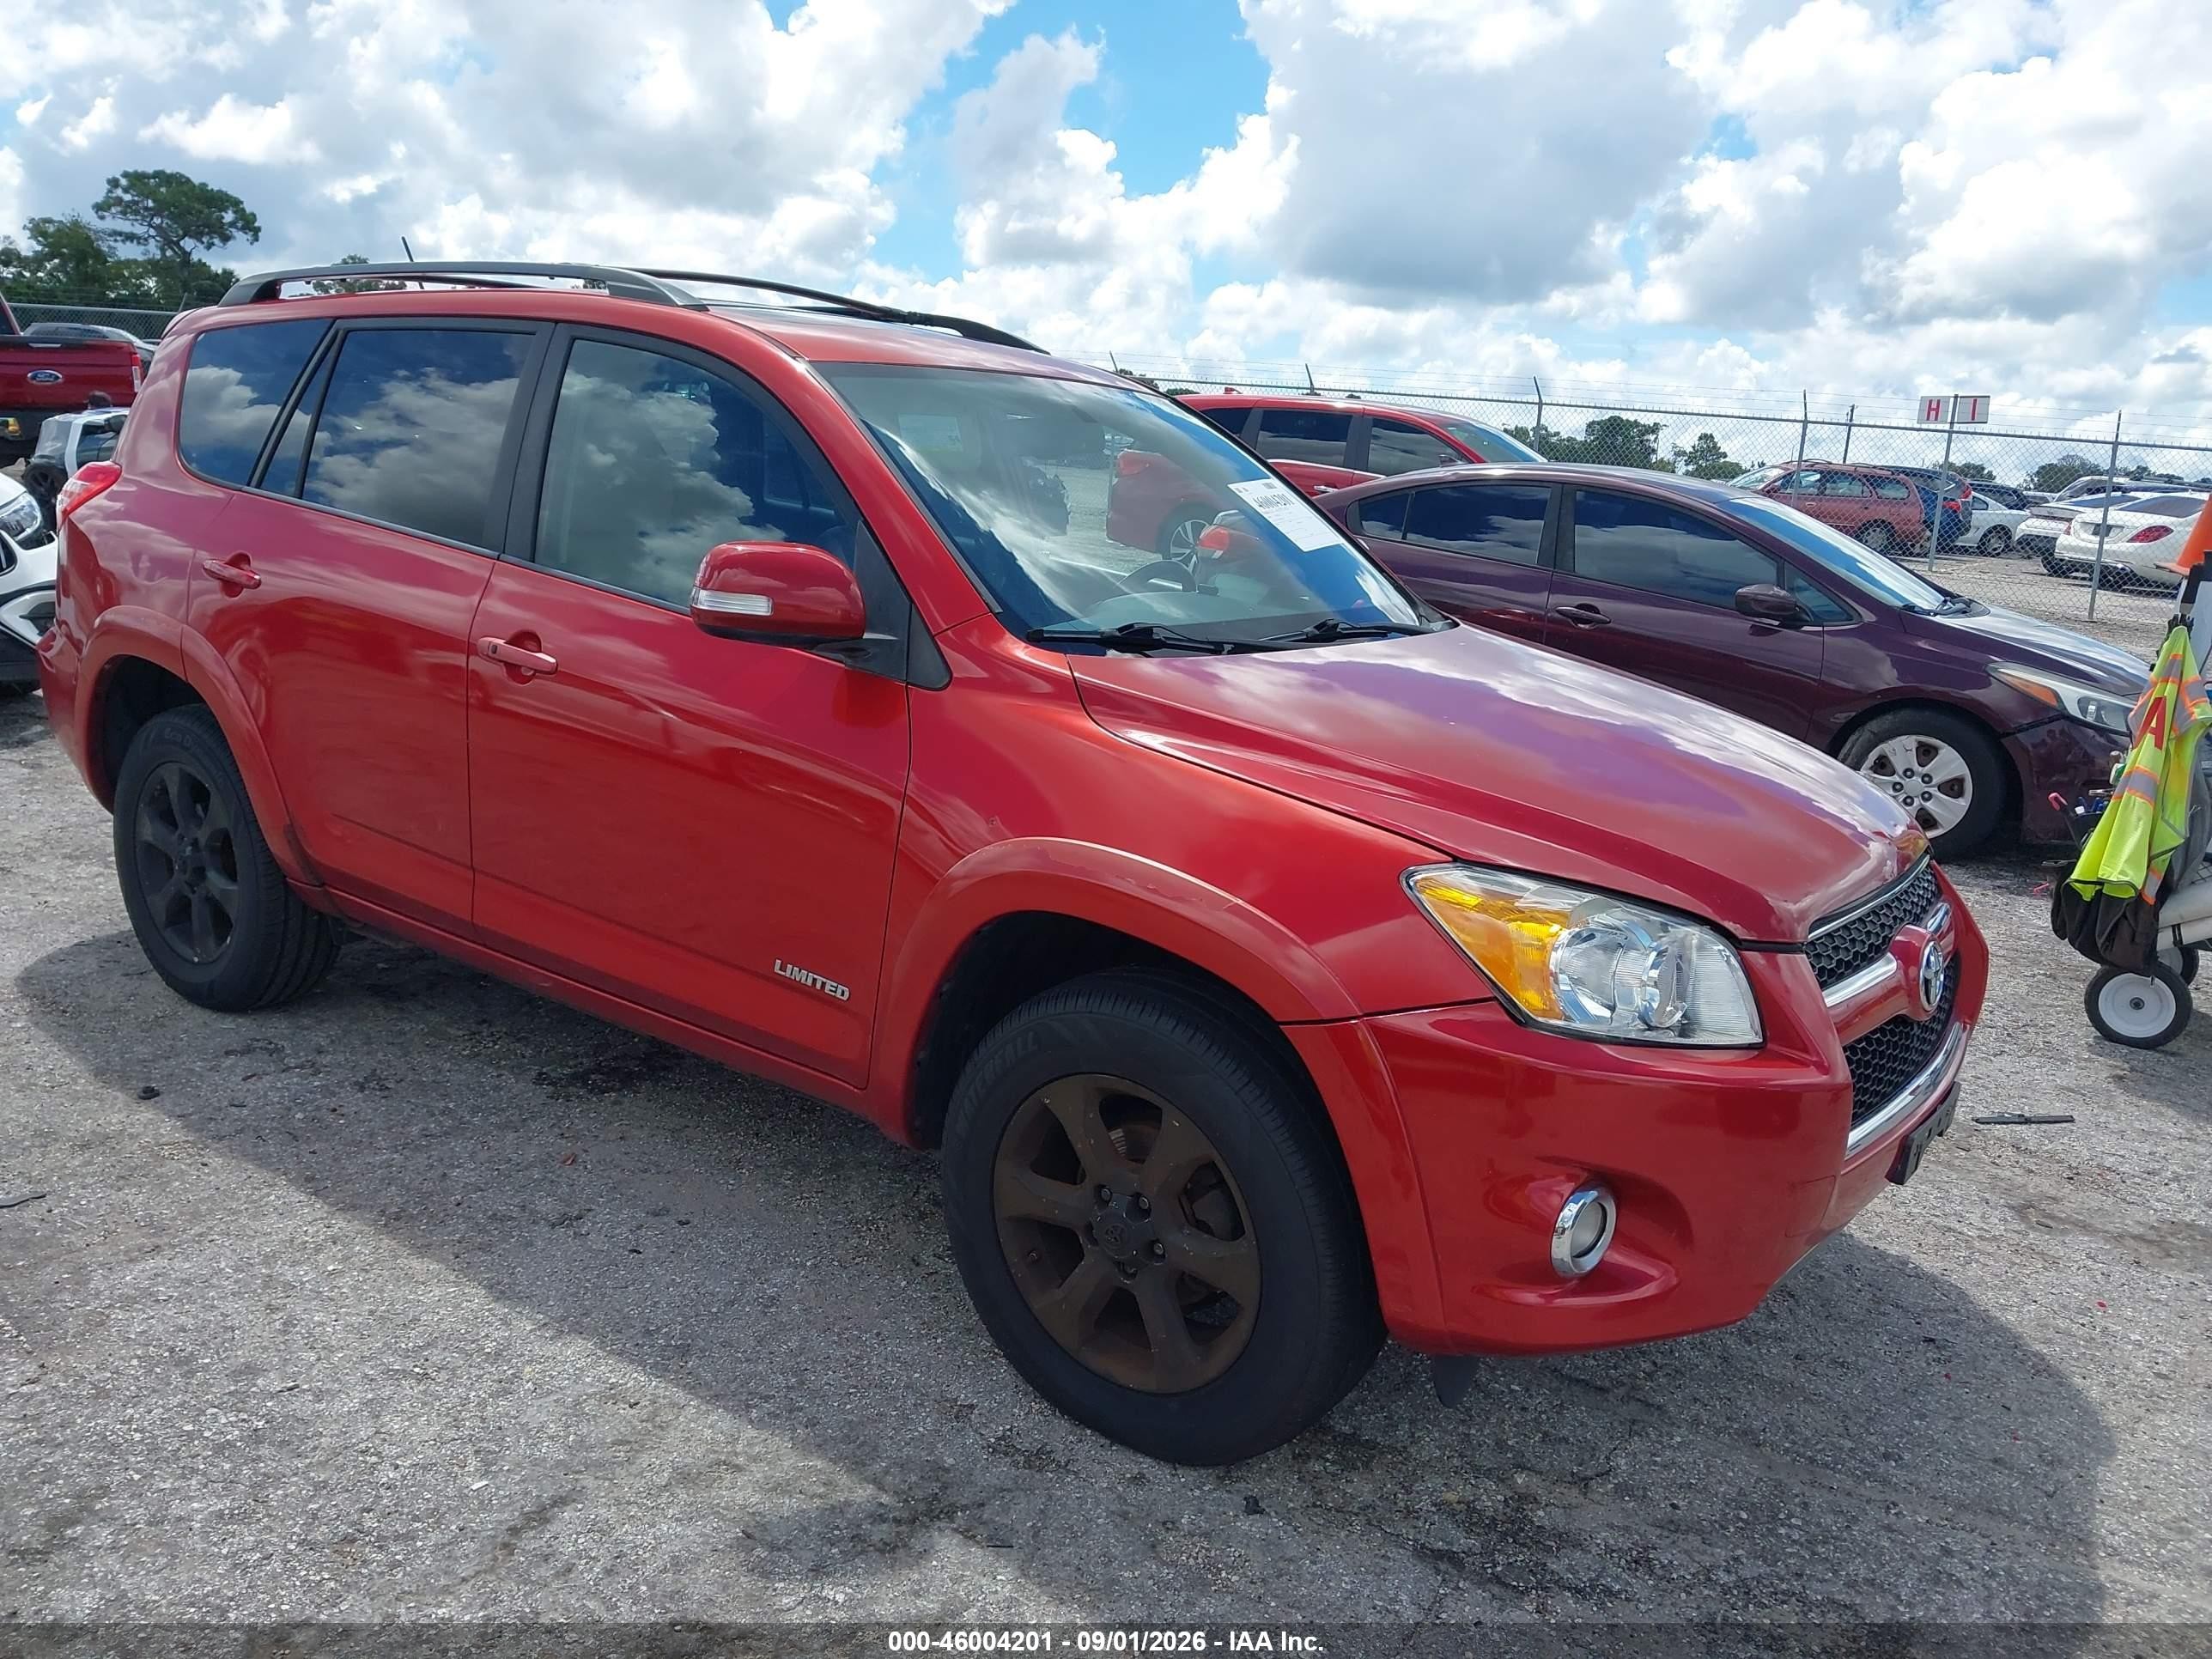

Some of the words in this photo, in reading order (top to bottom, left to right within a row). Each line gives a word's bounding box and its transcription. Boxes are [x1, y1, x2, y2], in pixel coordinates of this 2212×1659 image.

[1926, 398, 1941, 422] H
[1251, 493, 1296, 511] 46004201
[2132, 695, 2167, 750] A
[774, 958, 850, 1002] LIMITED
